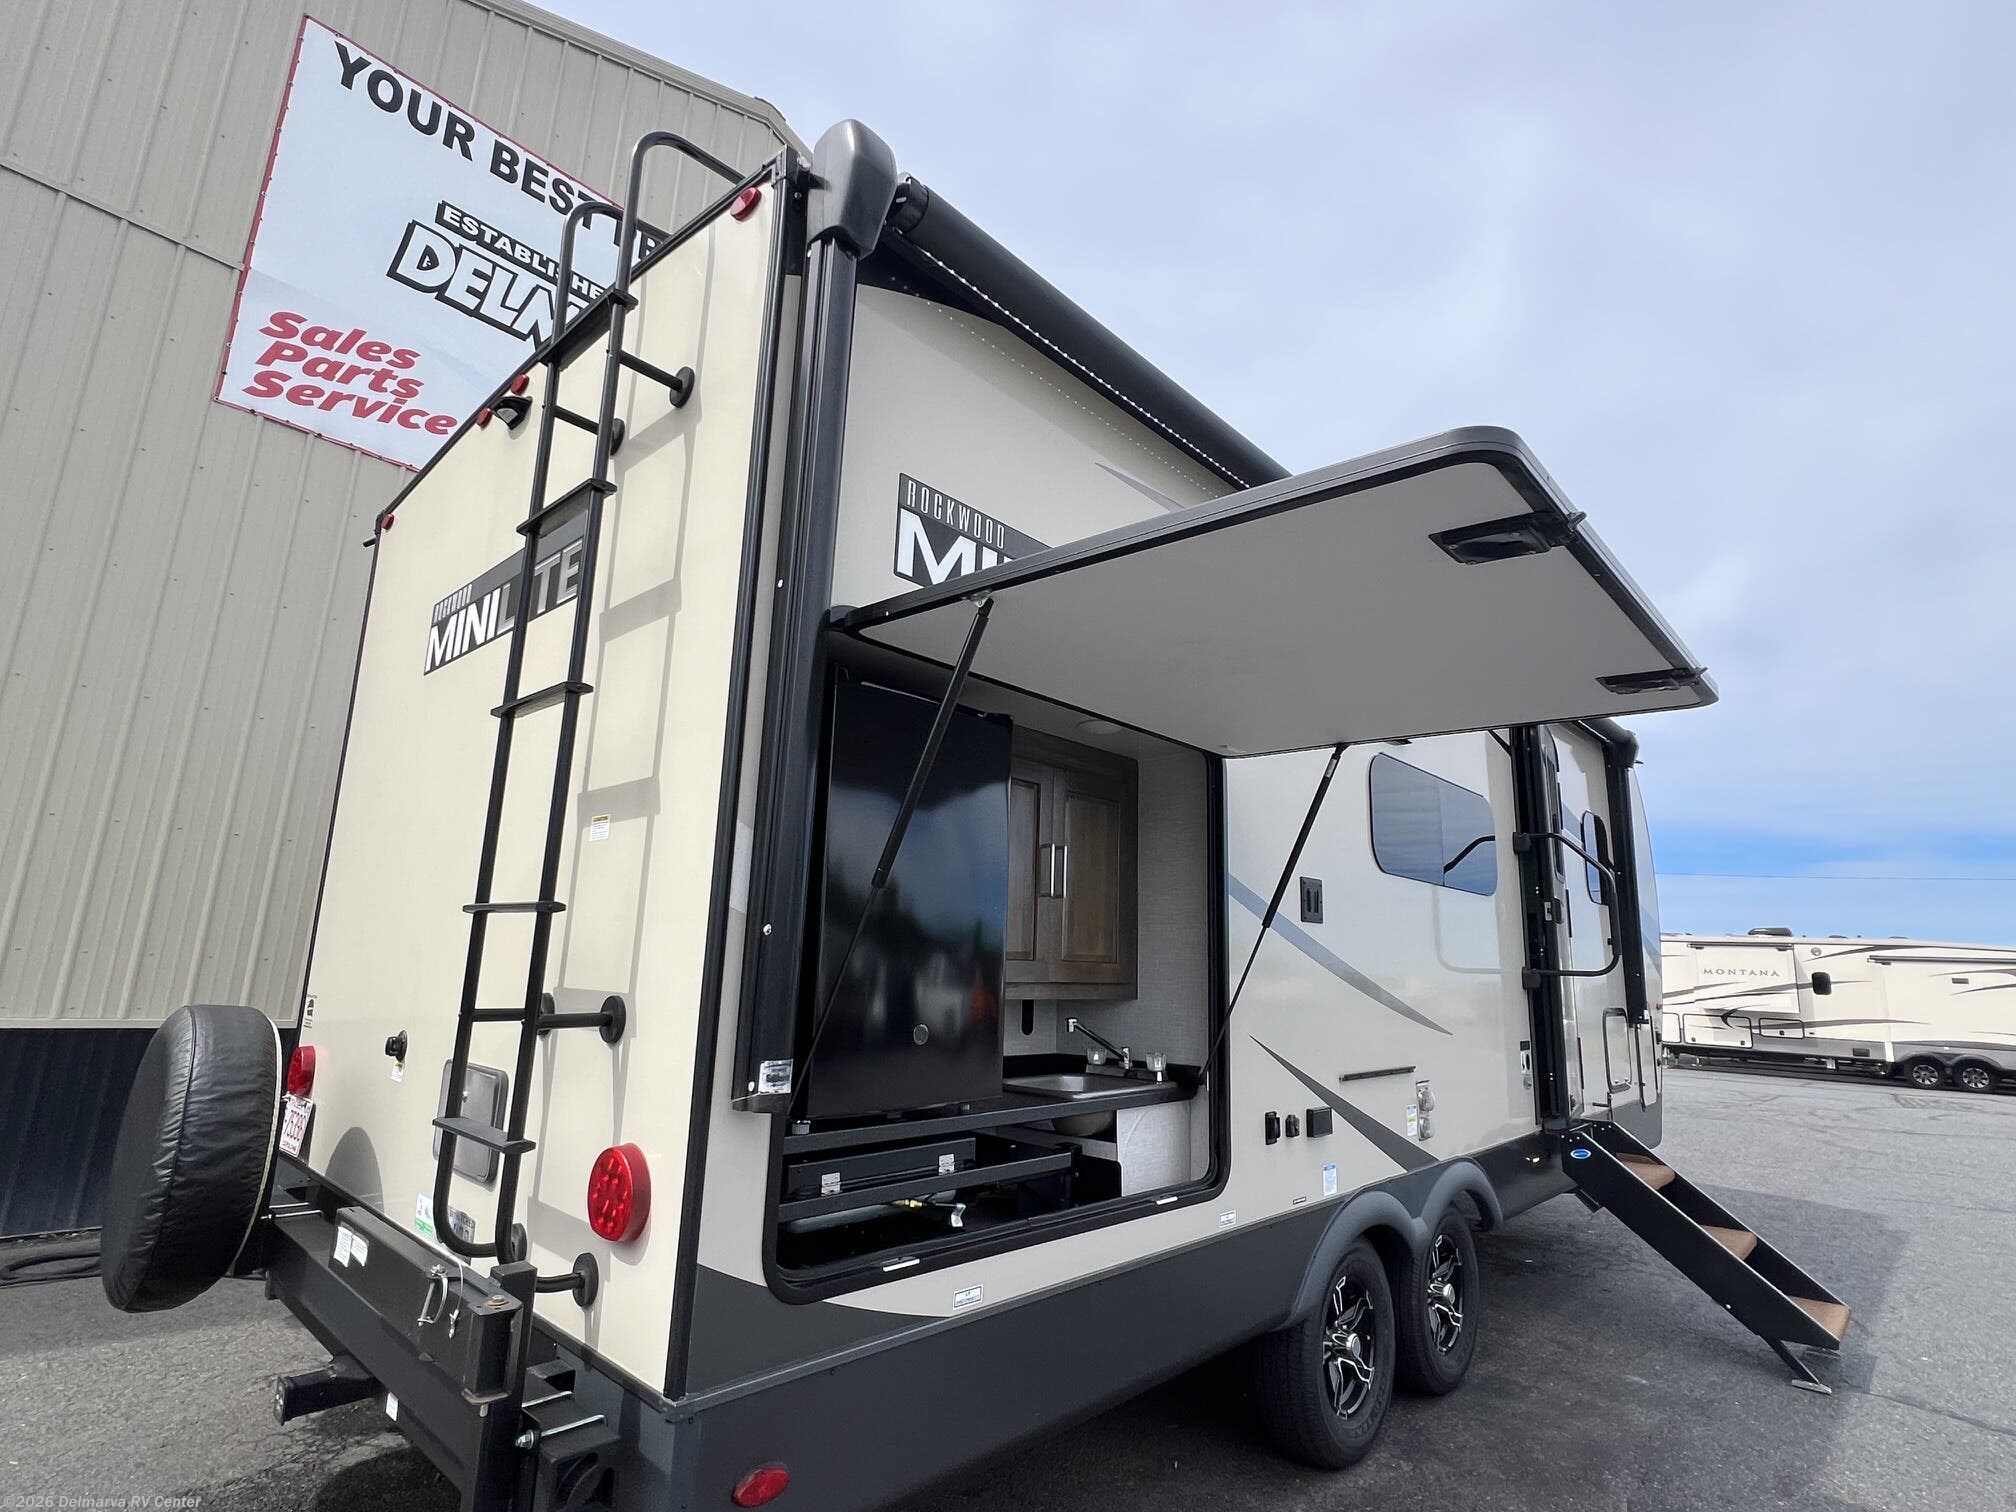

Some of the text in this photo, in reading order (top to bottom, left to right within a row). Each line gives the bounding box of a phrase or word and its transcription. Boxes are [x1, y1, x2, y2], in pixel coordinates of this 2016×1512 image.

[334, 40, 602, 230] YOUR BEST
[442, 207, 606, 298] ESTABLIHE
[255, 341, 424, 399] Parts
[259, 311, 421, 369] Sales
[242, 370, 458, 435] Service
[907, 480, 1005, 549] ROCKWOOD
[424, 540, 583, 672] MINILTE
[1703, 968, 1780, 977] MONTANA
